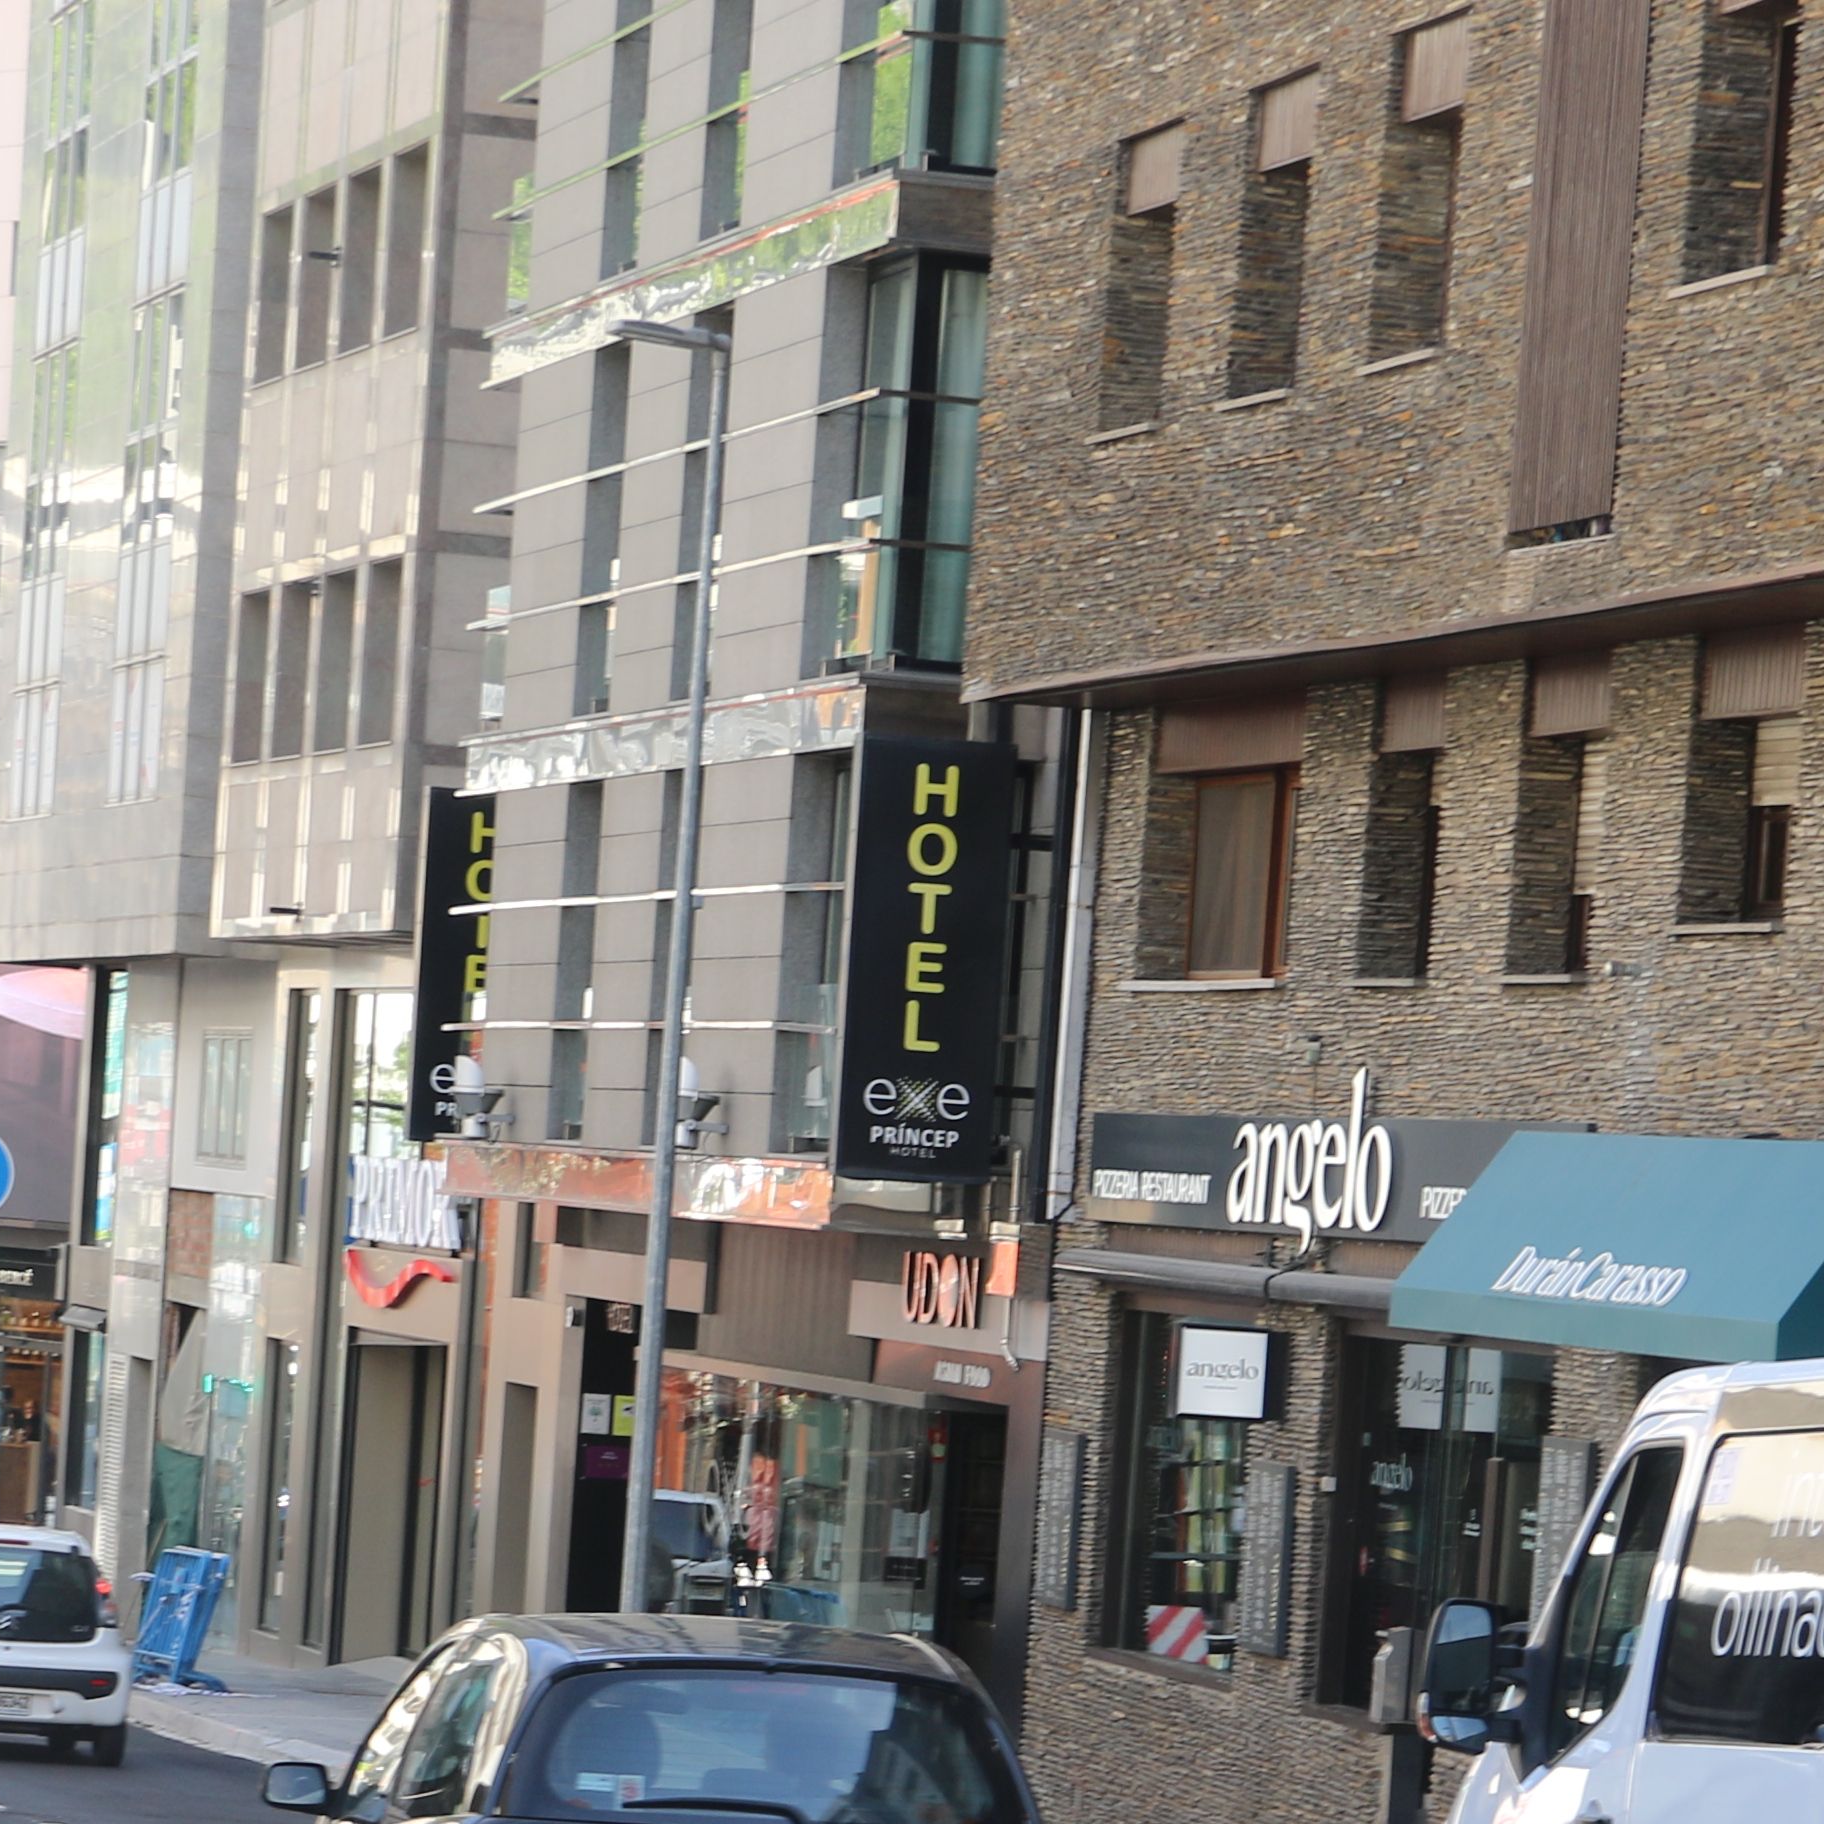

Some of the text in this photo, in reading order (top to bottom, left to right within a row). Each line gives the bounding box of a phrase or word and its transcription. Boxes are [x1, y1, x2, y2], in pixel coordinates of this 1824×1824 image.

[903, 763, 960, 1053] HOTEL
[863, 1076, 970, 1121] exe
[869, 1122, 960, 1148] PRÍNCEP
[889, 1146, 936, 1159] HOTEL
[1227, 1067, 1392, 1255] angelo
[350, 1155, 462, 1251] PRIMOR
[1092, 1169, 1211, 1204] PIZZERIA RESTAURANT
[902, 1251, 980, 1329] UDON
[1490, 1245, 1689, 1308] Durán Carasso
[1186, 1358, 1259, 1381] angelo
